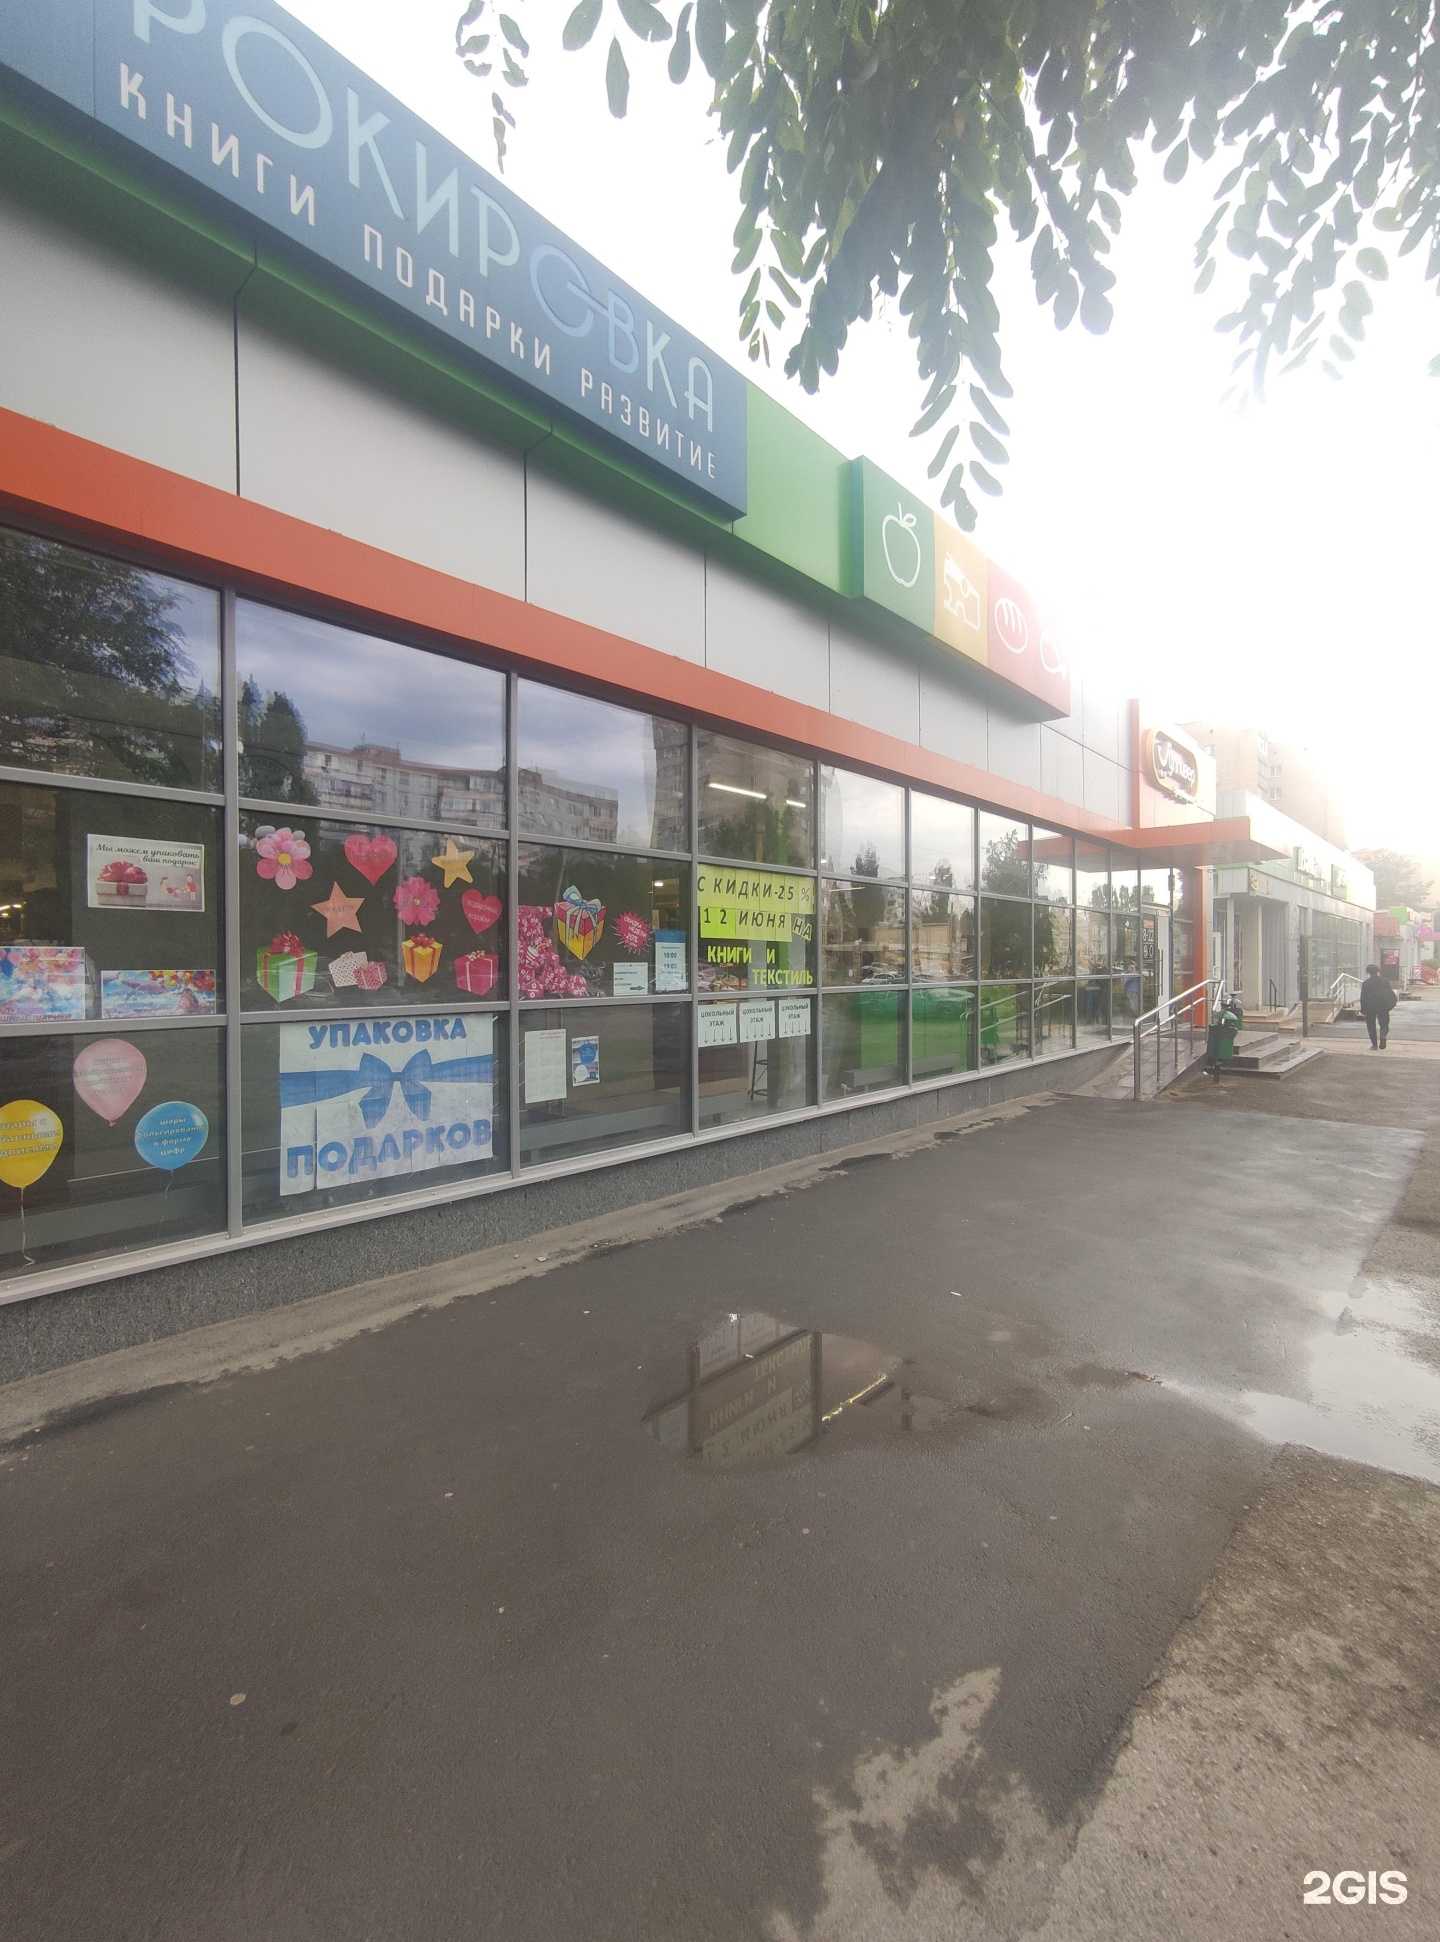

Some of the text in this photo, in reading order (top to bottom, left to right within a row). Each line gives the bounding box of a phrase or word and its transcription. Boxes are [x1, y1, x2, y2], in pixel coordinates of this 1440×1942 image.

[120, 62, 718, 479] КНИГИ ПОДАРКИ РАЗВИТИЕ
[739, 910, 785, 928] ИЮНЯ
[793, 918, 812, 940] НА
[707, 945, 752, 964] КНИГИ
[752, 968, 813, 985] ТЕКСТИЛЬ
[701, 1009, 735, 1018] ЦОКОЛЬНЫЙ
[307, 1017, 467, 1050] УПАКОВКА
[286, 1118, 492, 1179] ПОДАРКОВ
